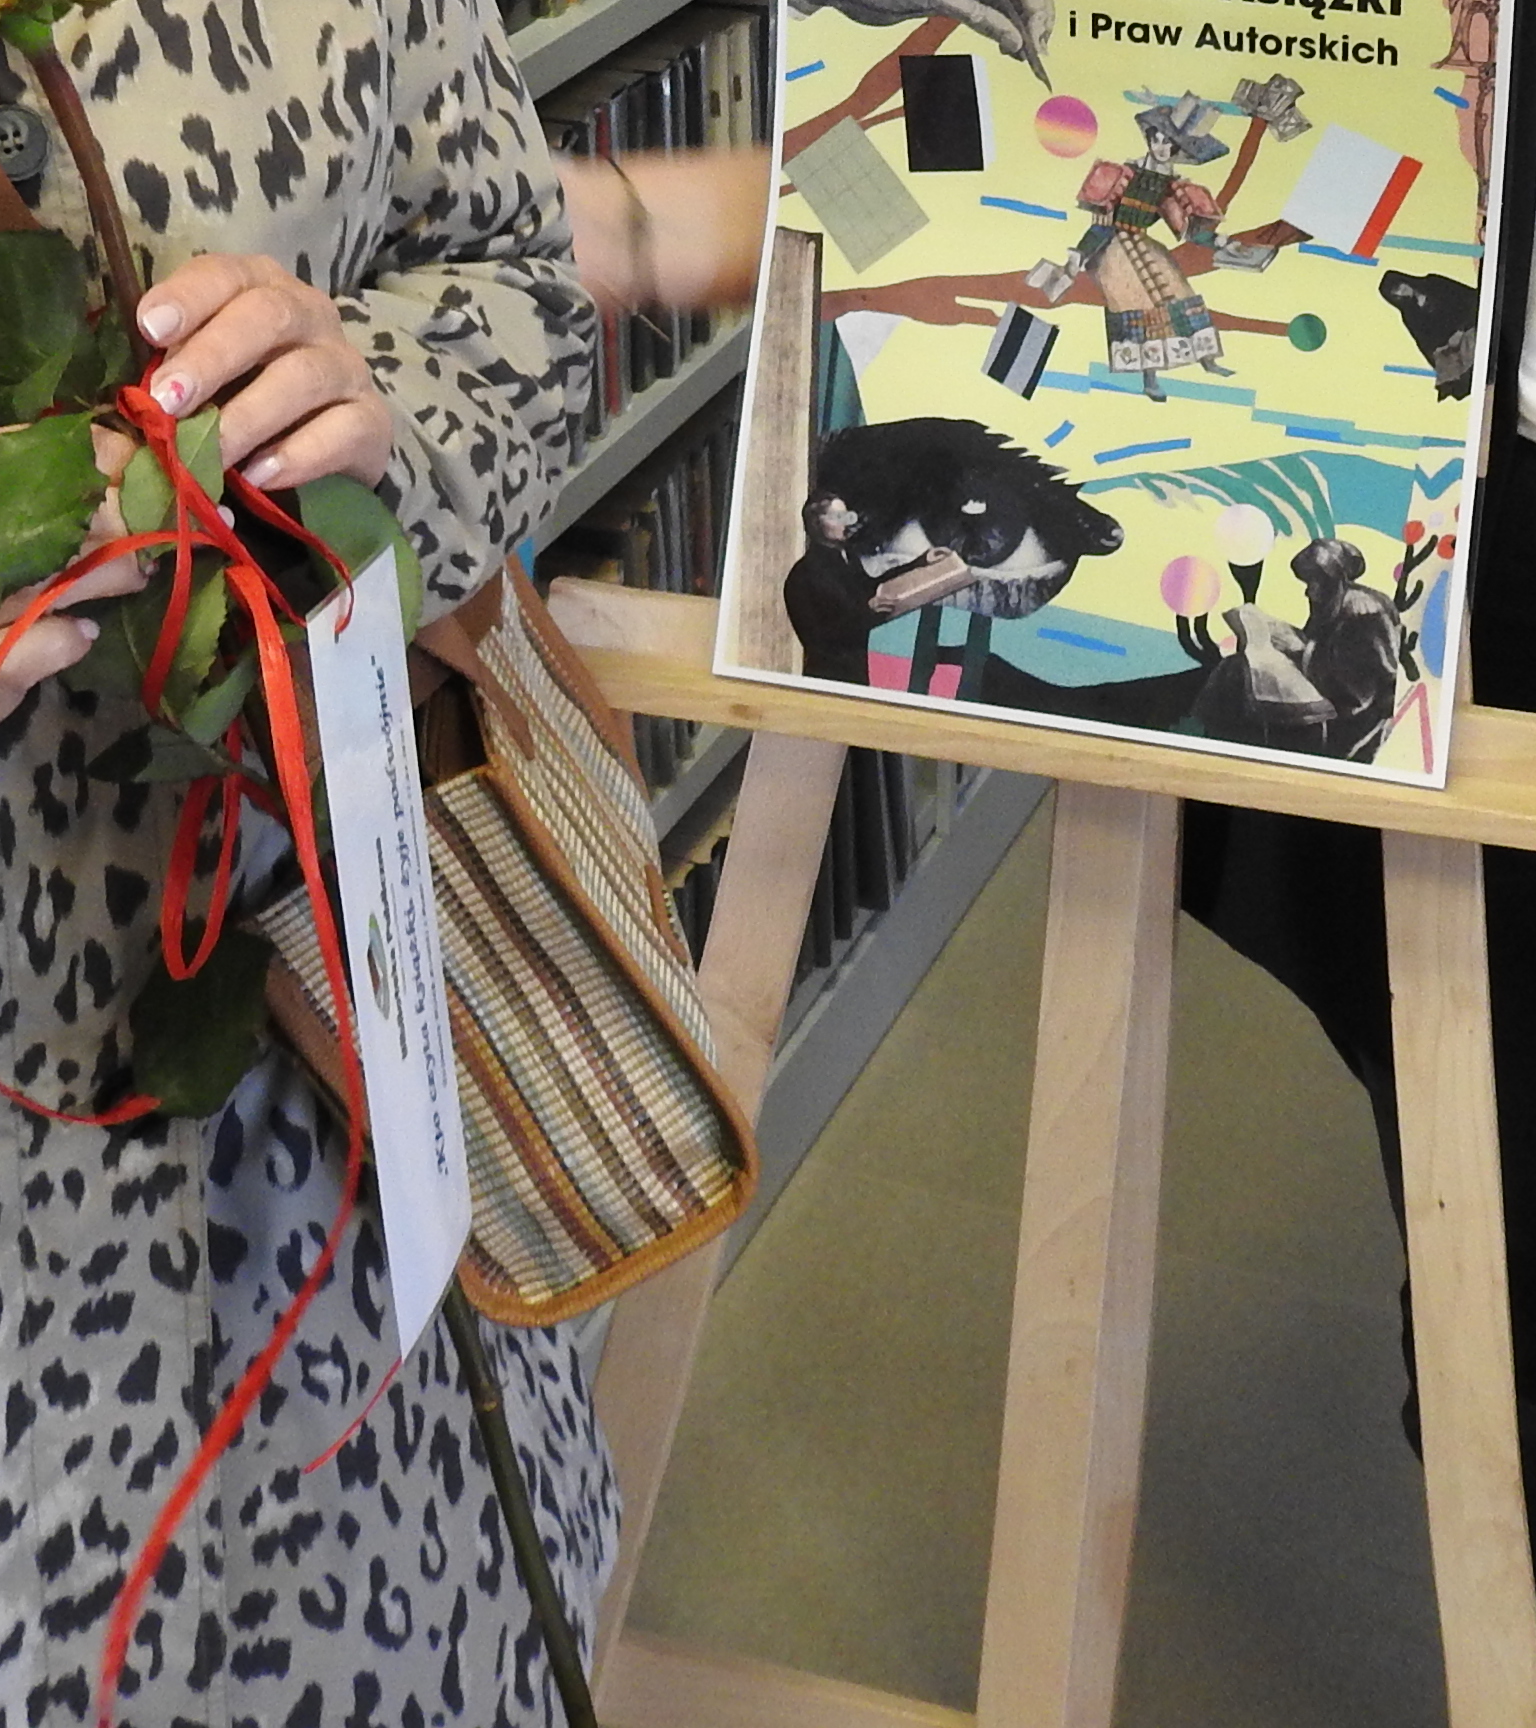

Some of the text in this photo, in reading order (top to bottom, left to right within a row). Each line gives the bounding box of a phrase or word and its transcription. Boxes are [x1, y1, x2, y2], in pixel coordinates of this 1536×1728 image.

[1068, 9, 1399, 67] i Praw Autorskich
